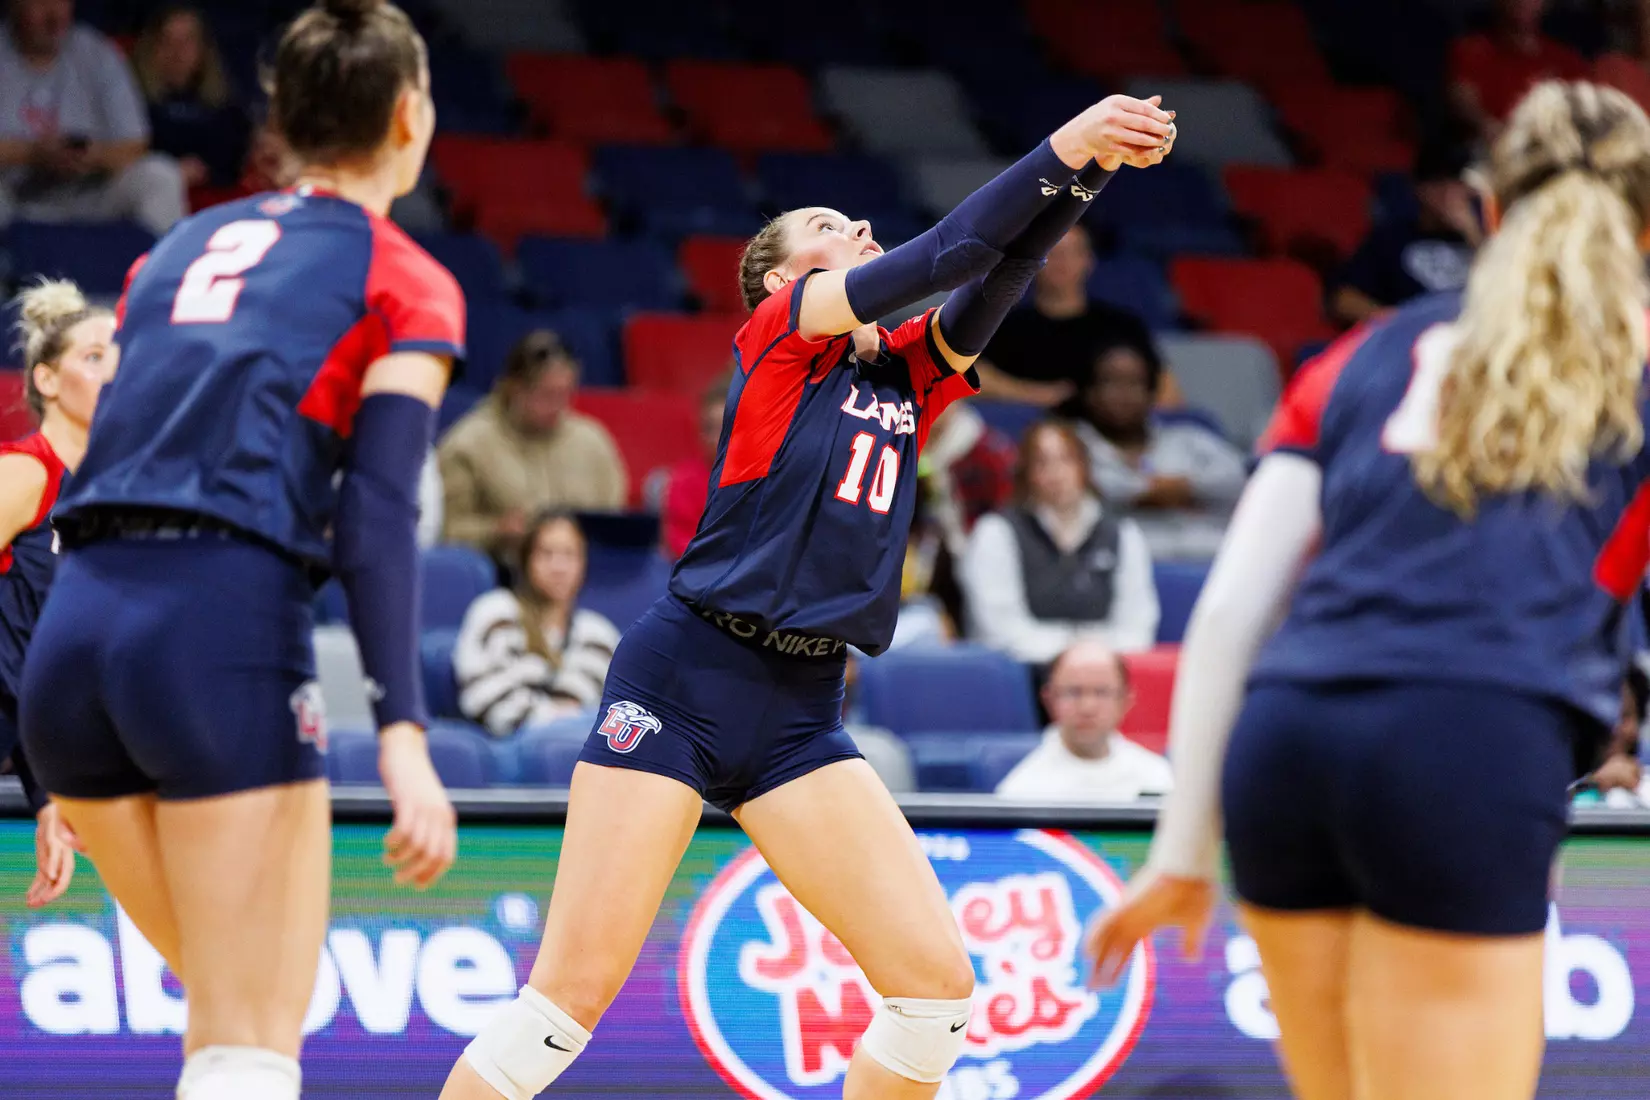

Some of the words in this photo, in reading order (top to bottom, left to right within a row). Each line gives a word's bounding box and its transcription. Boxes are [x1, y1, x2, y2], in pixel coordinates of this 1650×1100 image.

[169, 219, 283, 325] 2
[834, 430, 901, 515] 10
[702, 609, 757, 638] RO
[762, 631, 832, 656] NIKE
